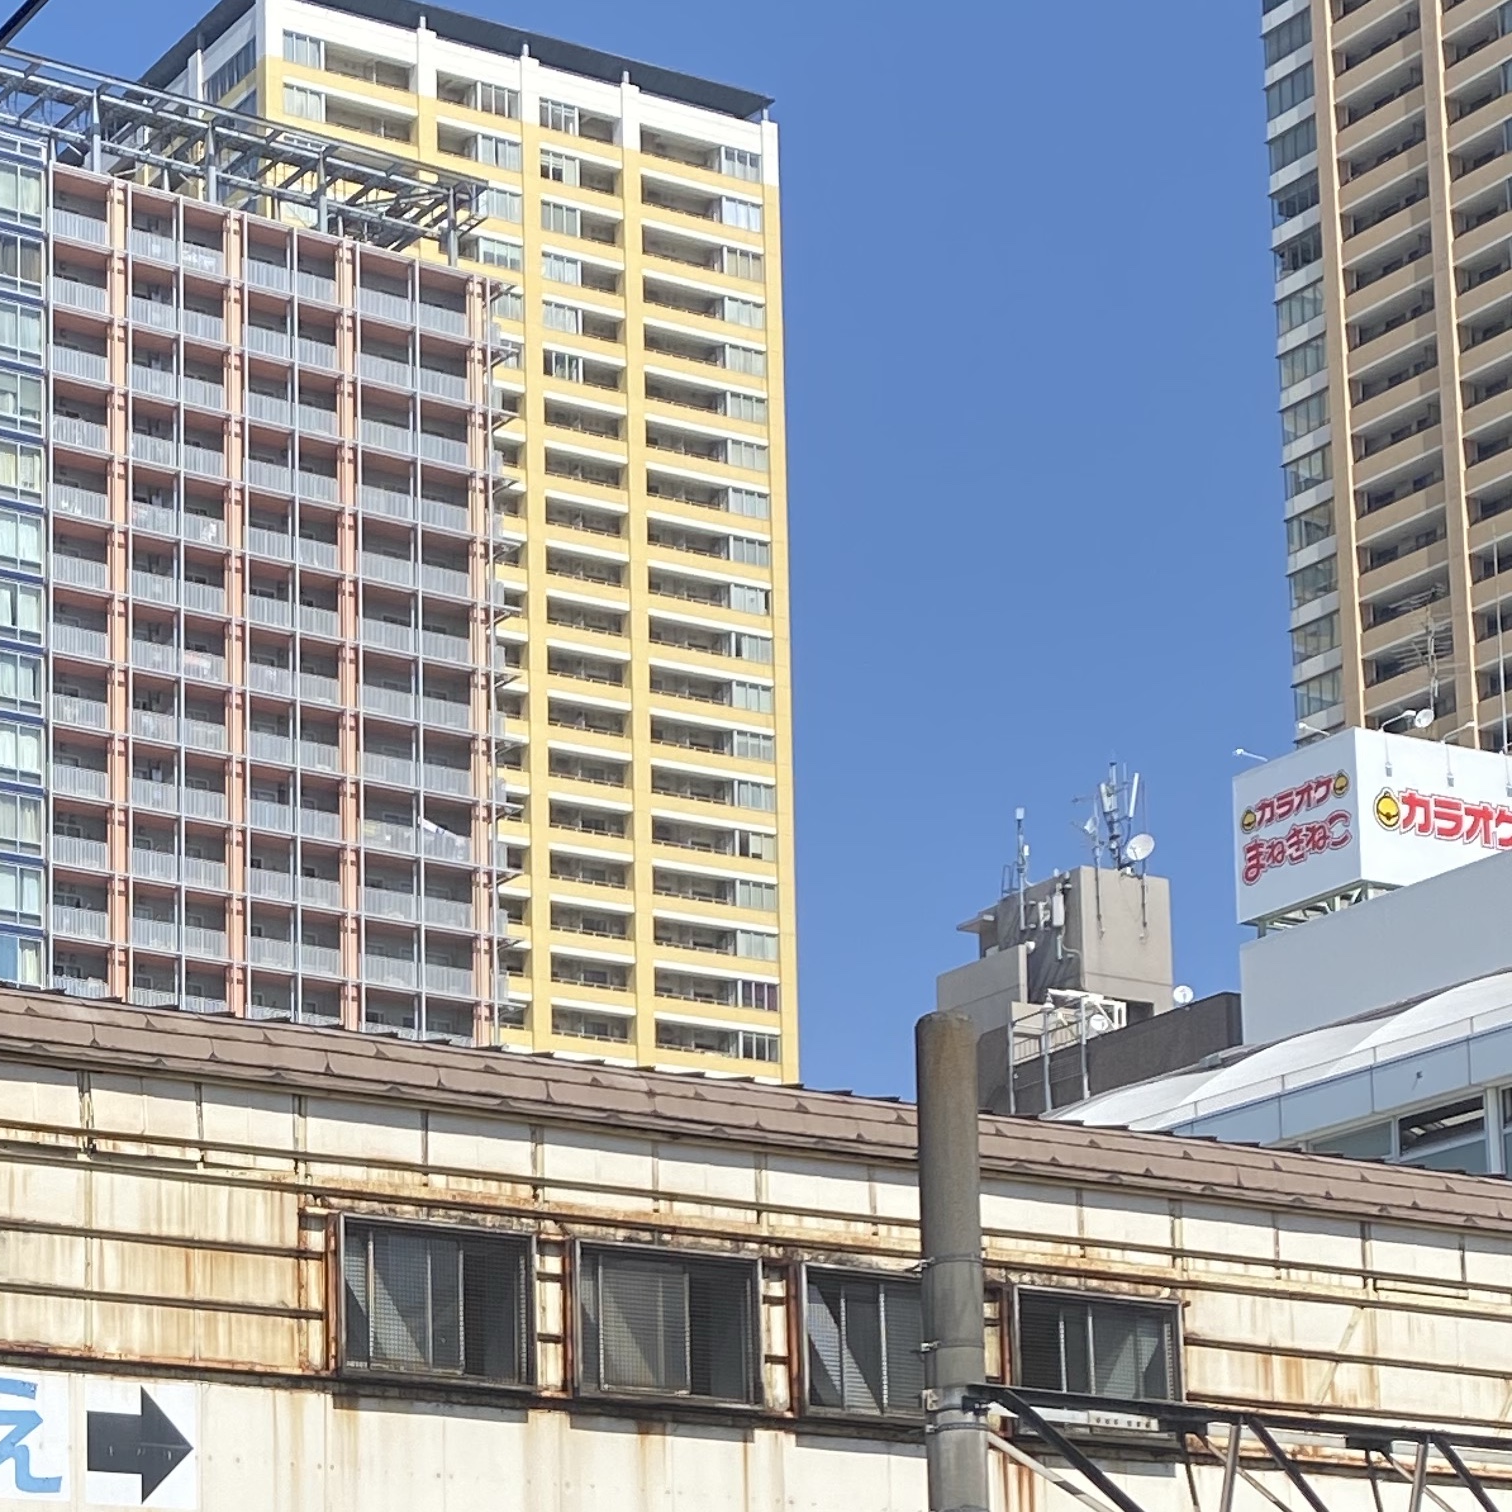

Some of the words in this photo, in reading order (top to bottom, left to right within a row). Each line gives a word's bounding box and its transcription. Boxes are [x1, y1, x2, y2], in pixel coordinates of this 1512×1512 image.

[1255, 776, 1333, 827] カラオケ
[1242, 811, 1351, 884] まねきねこ
